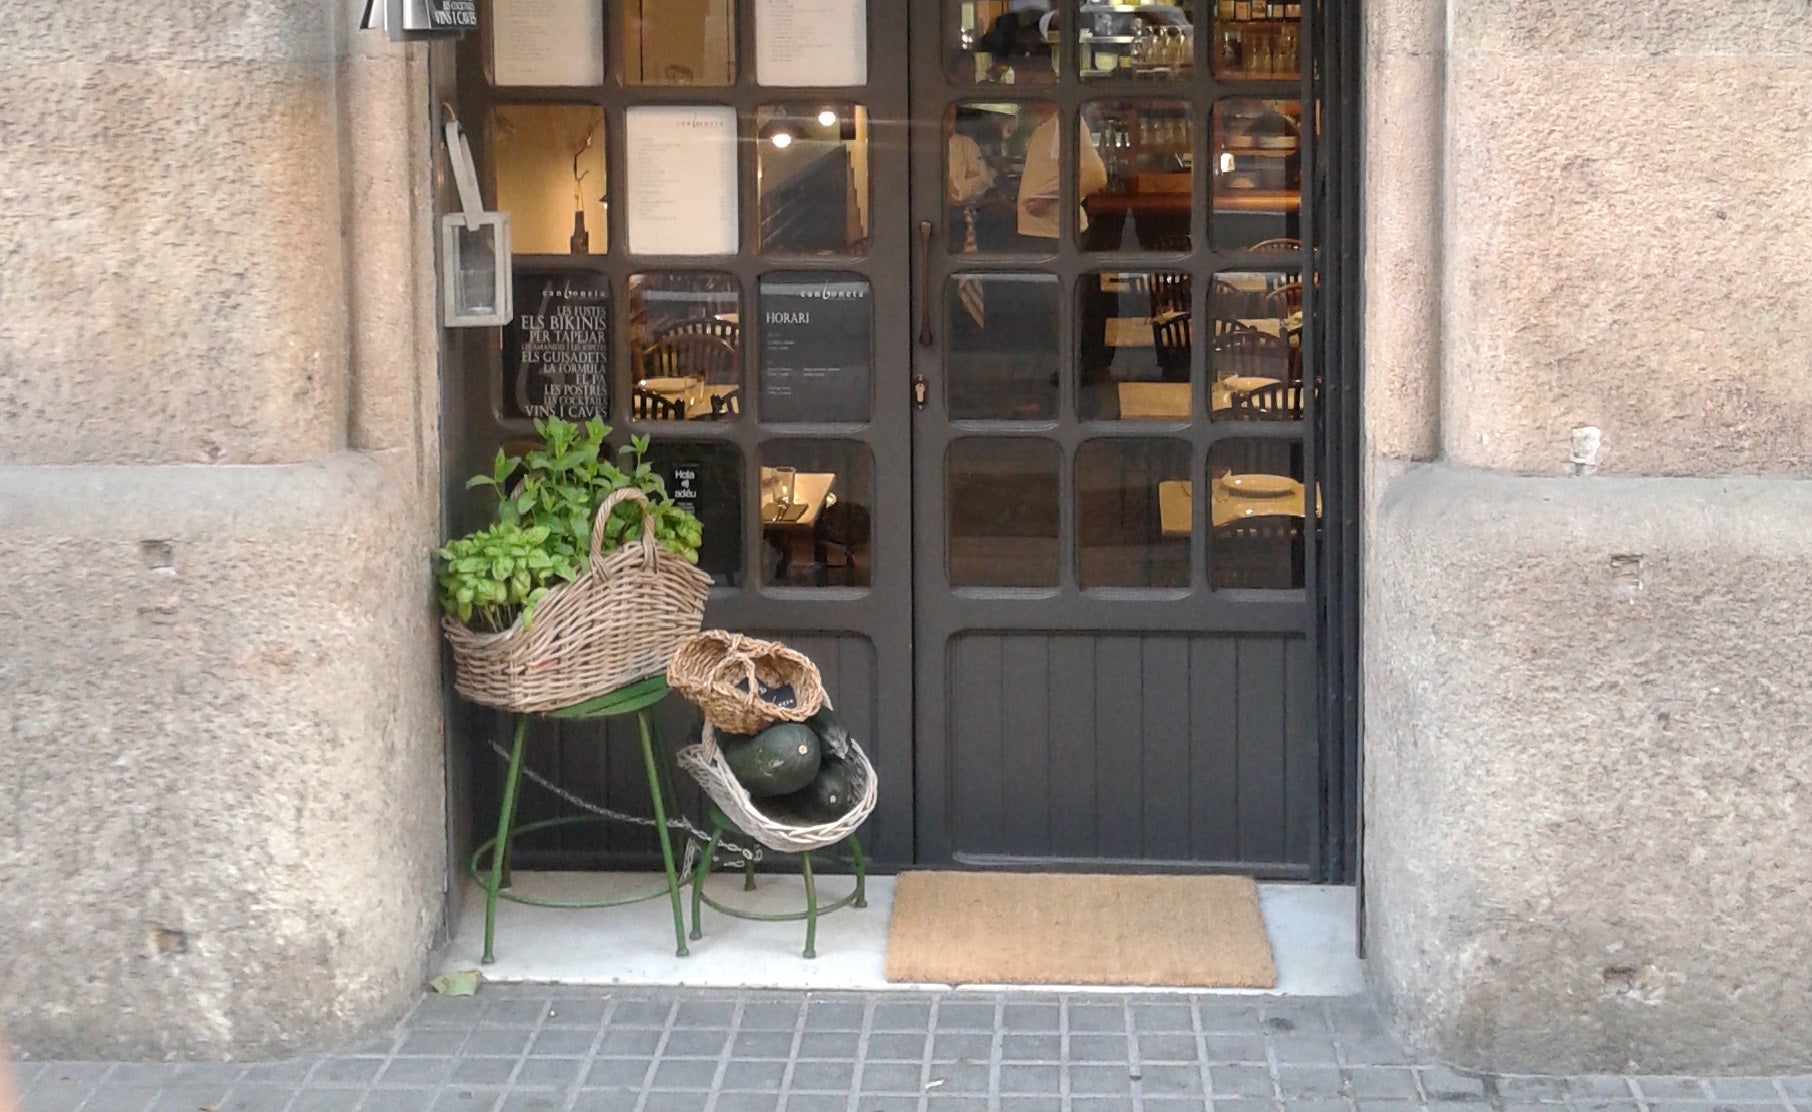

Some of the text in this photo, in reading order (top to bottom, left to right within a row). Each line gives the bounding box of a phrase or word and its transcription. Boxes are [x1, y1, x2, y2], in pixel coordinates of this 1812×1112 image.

[434, 10, 452, 24] VINS
[521, 315, 607, 331] ELS BIKINIS
[766, 311, 810, 324] HORARI
[529, 330, 605, 344] PER TAPEJAR
[522, 351, 607, 363] ELS GUISADETS
[543, 363, 606, 374] LA FORMULA
[576, 374, 606, 385] EL PA
[544, 384, 607, 396] LES POSTRES
[525, 406, 607, 418] VINS I CAVES
[675, 469, 695, 479] Hola
